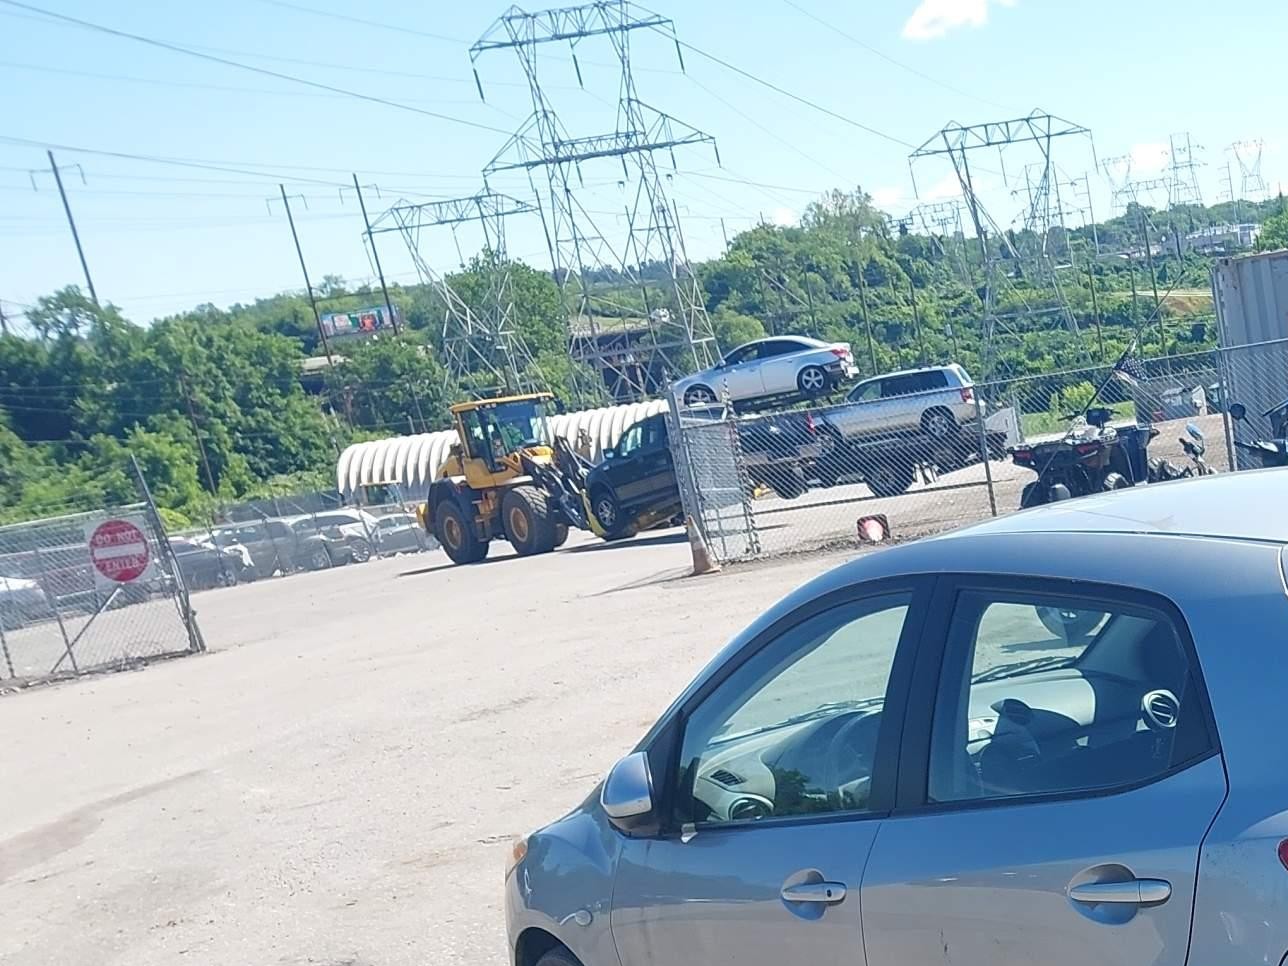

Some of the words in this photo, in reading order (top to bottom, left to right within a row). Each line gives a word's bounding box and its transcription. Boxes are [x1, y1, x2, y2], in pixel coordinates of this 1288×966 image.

[95, 533, 111, 546] DO
[117, 529, 139, 543] NOT
[103, 555, 140, 571] ENTER
